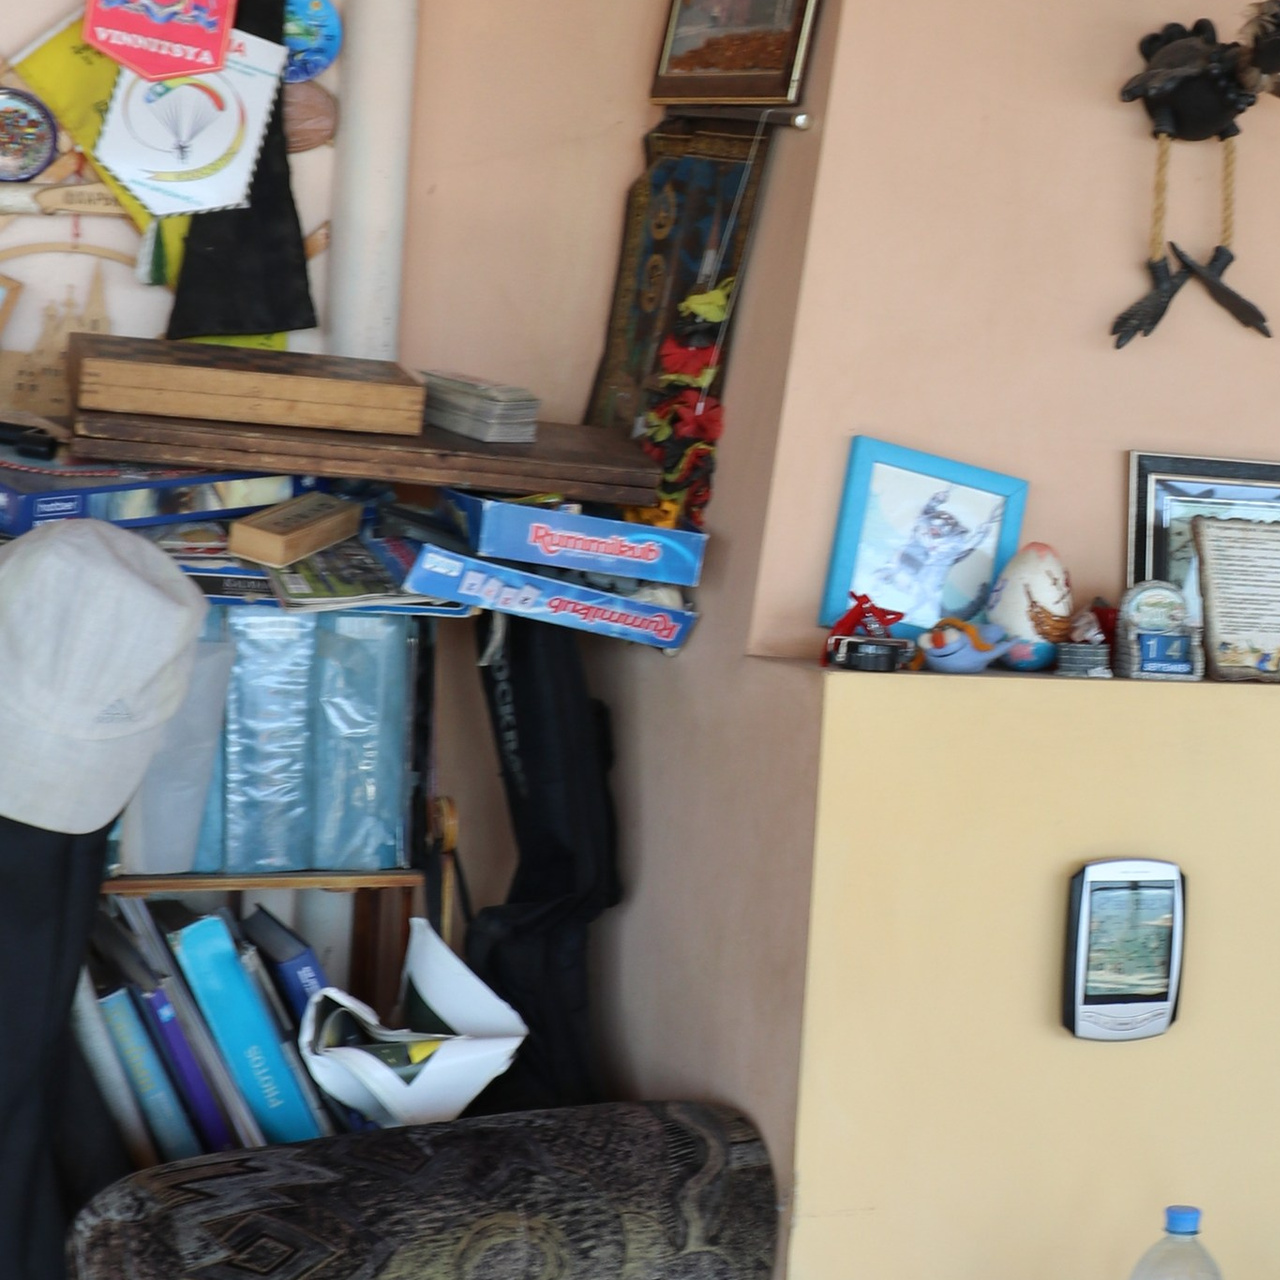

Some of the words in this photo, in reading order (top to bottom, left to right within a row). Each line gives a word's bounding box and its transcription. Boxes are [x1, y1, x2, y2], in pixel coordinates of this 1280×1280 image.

[529, 523, 662, 562] Rummikub
[546, 596, 682, 641] Rummikub
[244, 1045, 285, 1109] PHOTOS
